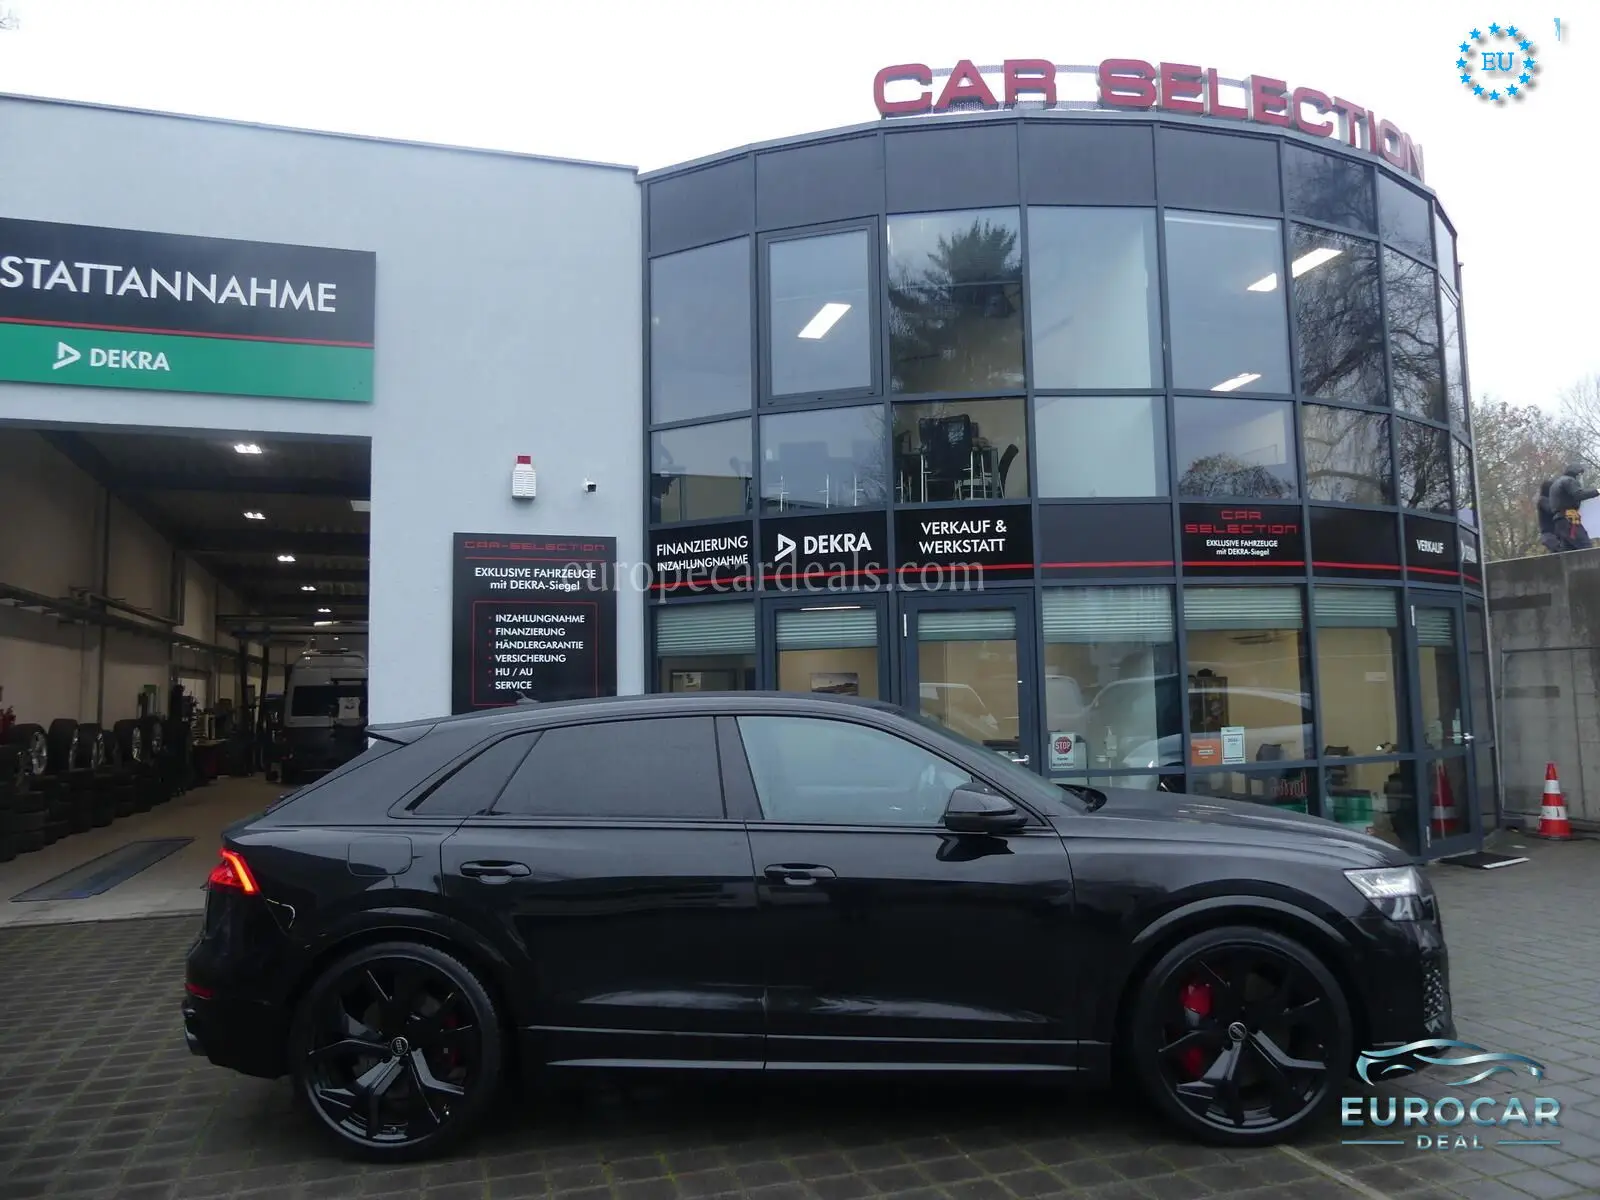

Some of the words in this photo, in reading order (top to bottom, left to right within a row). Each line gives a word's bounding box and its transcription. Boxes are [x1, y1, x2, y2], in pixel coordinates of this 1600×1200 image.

[873, 58, 1057, 115] CAR
[1098, 58, 1425, 182] SELECTION
[0, 255, 337, 313] STATTANNAHME
[89, 347, 171, 372] DEKRA
[1221, 510, 1262, 520] CAR
[920, 520, 991, 535] VERKAUF
[995, 519, 1007, 534] &
[1184, 524, 1297, 534] SELECTION
[656, 535, 749, 557] FINANZIERUNG
[803, 532, 872, 555] DEKRA
[919, 538, 1006, 554] WERKSTATT
[1241, 540, 1278, 548] FAHRZEUGE
[1416, 539, 1444, 554] VERKAUF
[657, 554, 749, 572] INZAHLUNGNAHME
[475, 567, 531, 578] EXKLUSIVE
[534, 568, 597, 579] FAHRZEUGE
[490, 580, 507, 589] mit
[510, 580, 580, 592] DEKRA-Siegel
[495, 614, 585, 623] INZAHLUNGNAHME
[495, 627, 566, 636] FINANZIERUNG
[495, 639, 584, 650] HÄNDLERGARANTIE
[495, 654, 567, 663] VERSICHERUNG
[495, 668, 510, 676] HU
[519, 668, 533, 676] AU
[495, 681, 532, 690] SERVICE
[1055, 741, 1072, 750] STOP
